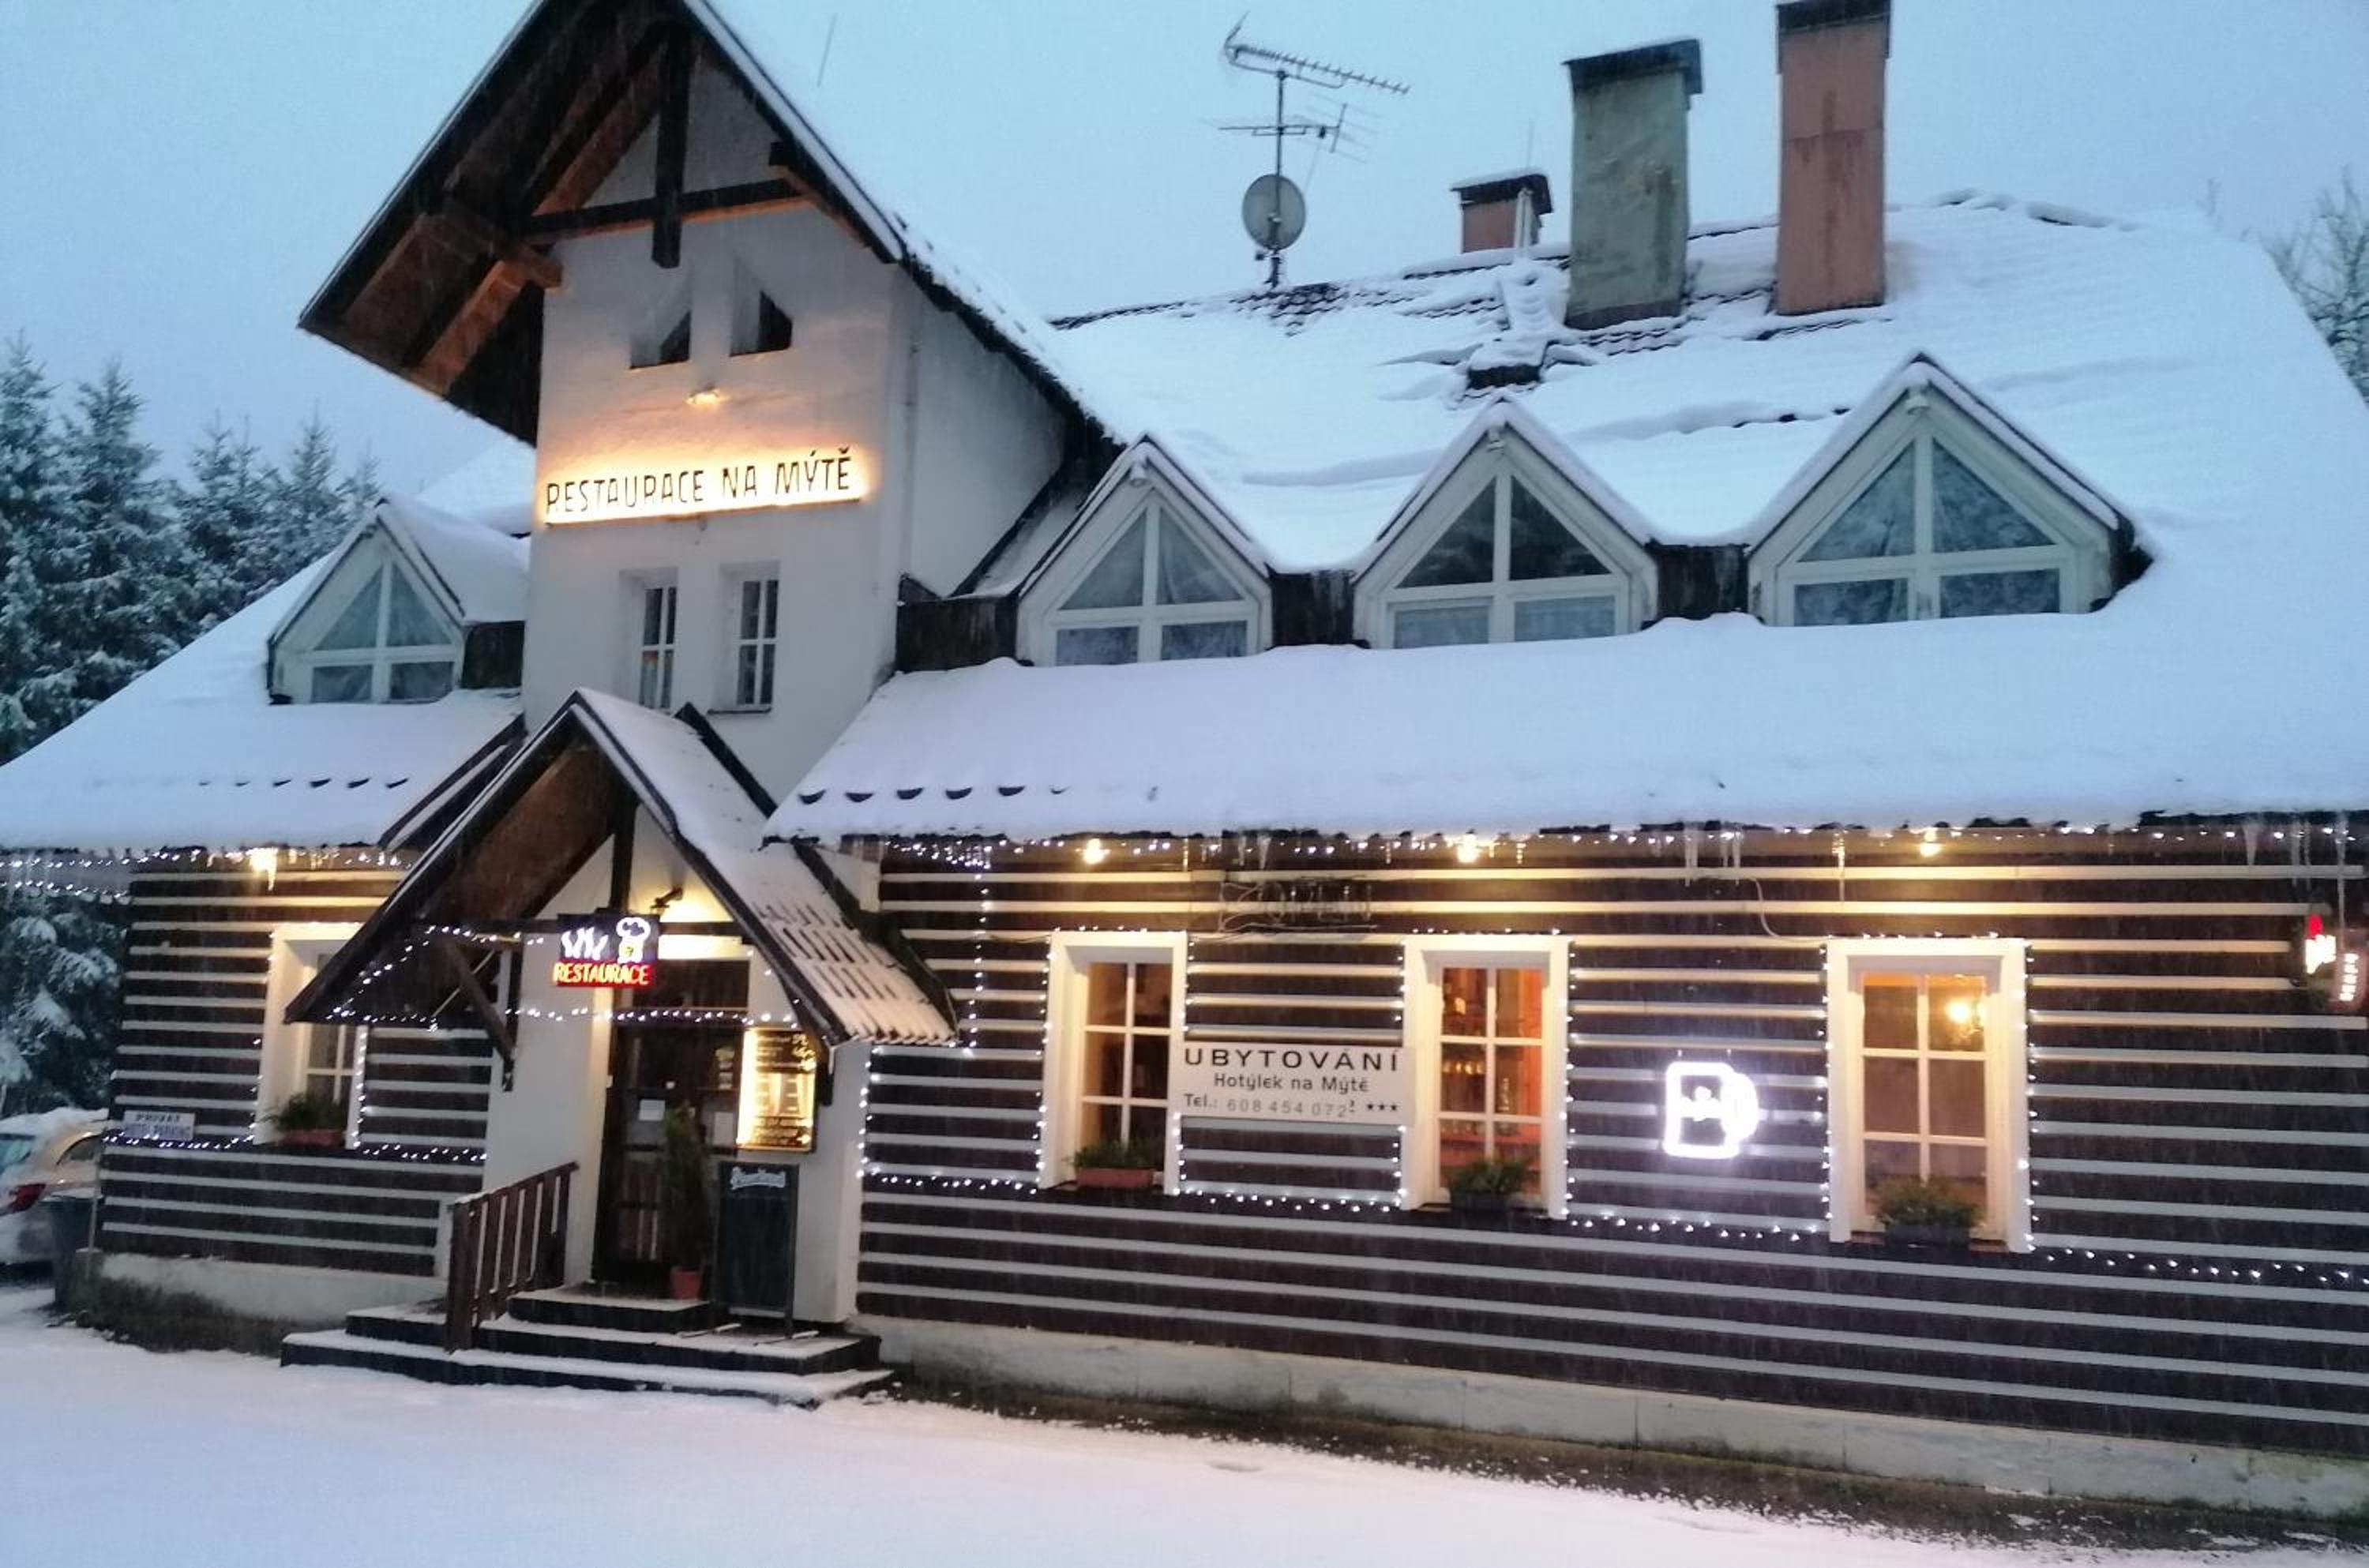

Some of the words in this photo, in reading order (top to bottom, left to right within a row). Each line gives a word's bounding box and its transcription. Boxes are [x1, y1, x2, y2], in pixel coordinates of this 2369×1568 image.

[546, 470, 704, 515] RESTAURACE
[721, 464, 758, 499] NA
[775, 447, 851, 495] MÝTĚ
[554, 962, 650, 985] RESTAURACE
[1185, 1048, 1397, 1071] UBYTOVÁNÍ
[1291, 1078, 1312, 1090] na
[1227, 1098, 1263, 1112] 608
[1268, 1101, 1303, 1114] 454
